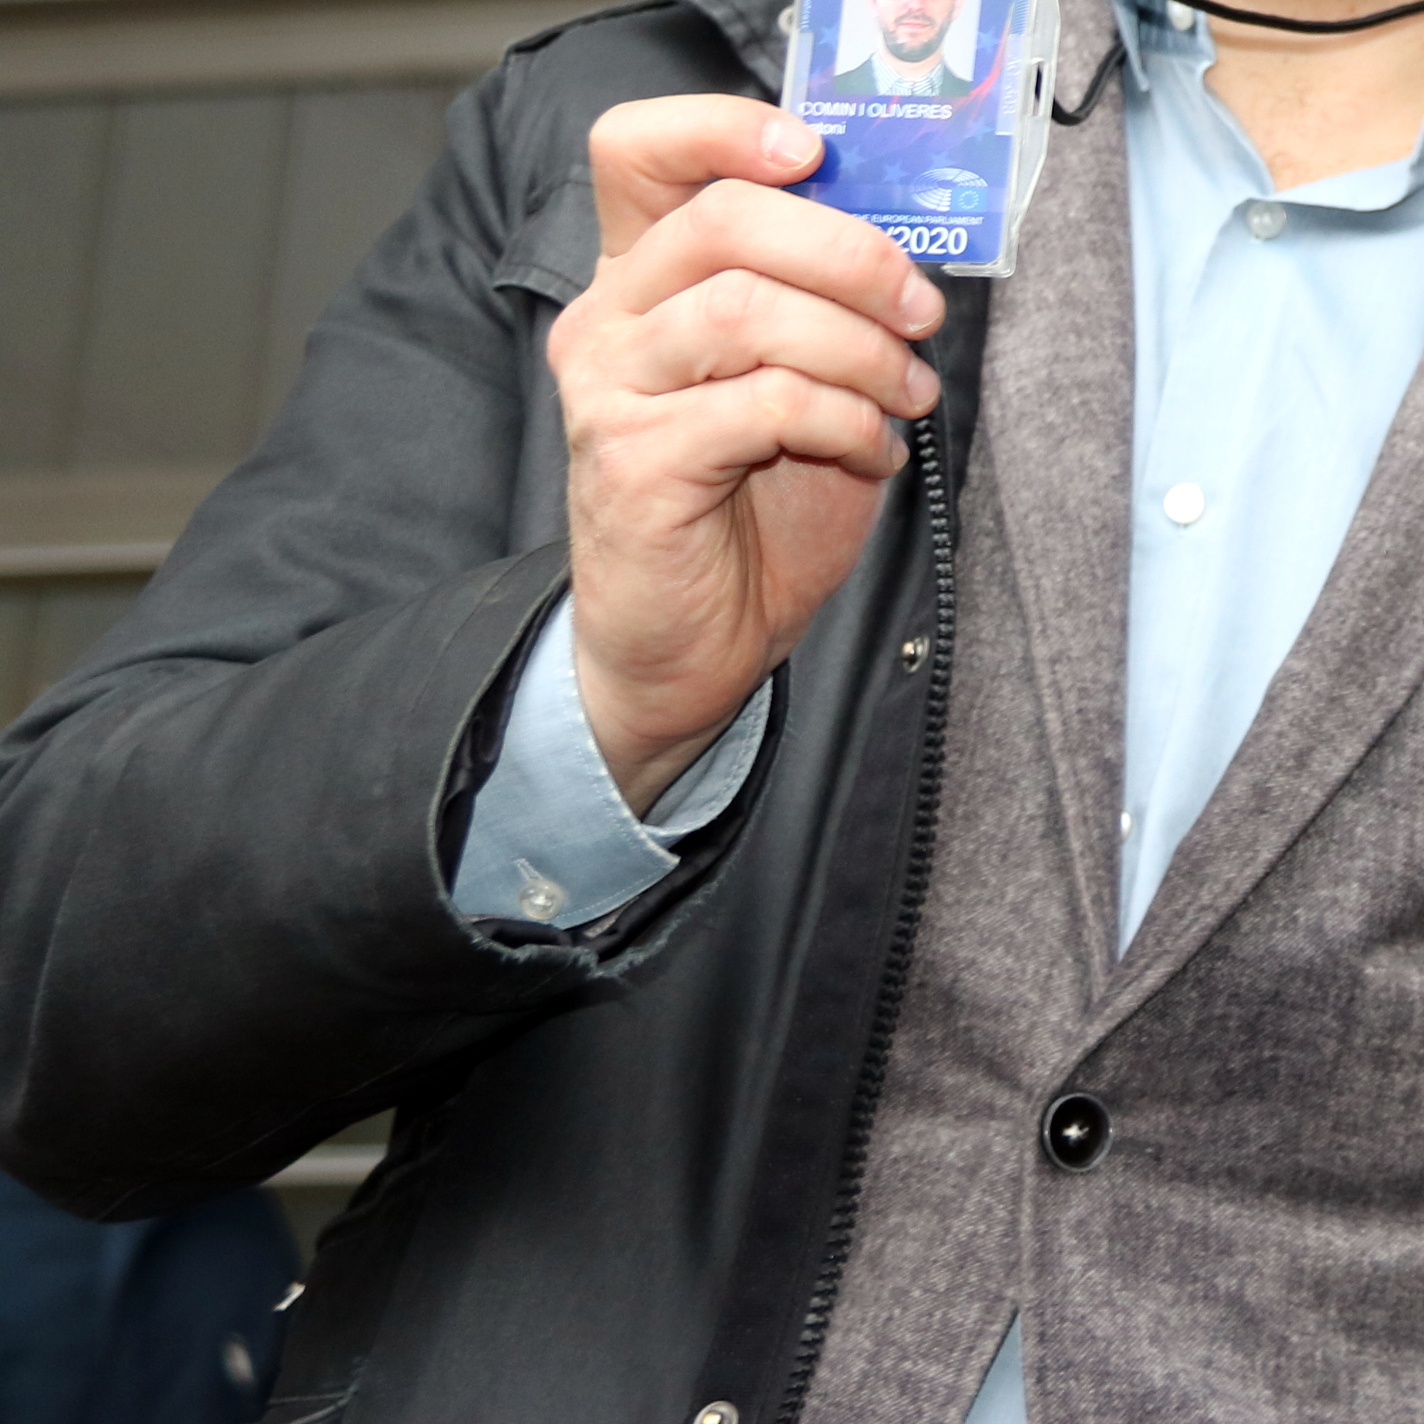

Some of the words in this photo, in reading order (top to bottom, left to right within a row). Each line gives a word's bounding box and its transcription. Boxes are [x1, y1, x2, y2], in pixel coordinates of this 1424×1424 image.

[866, 102, 954, 120] OLIVERES
[871, 213, 925, 224] EUROPEAN
[925, 215, 985, 227] PARLIAMENT
